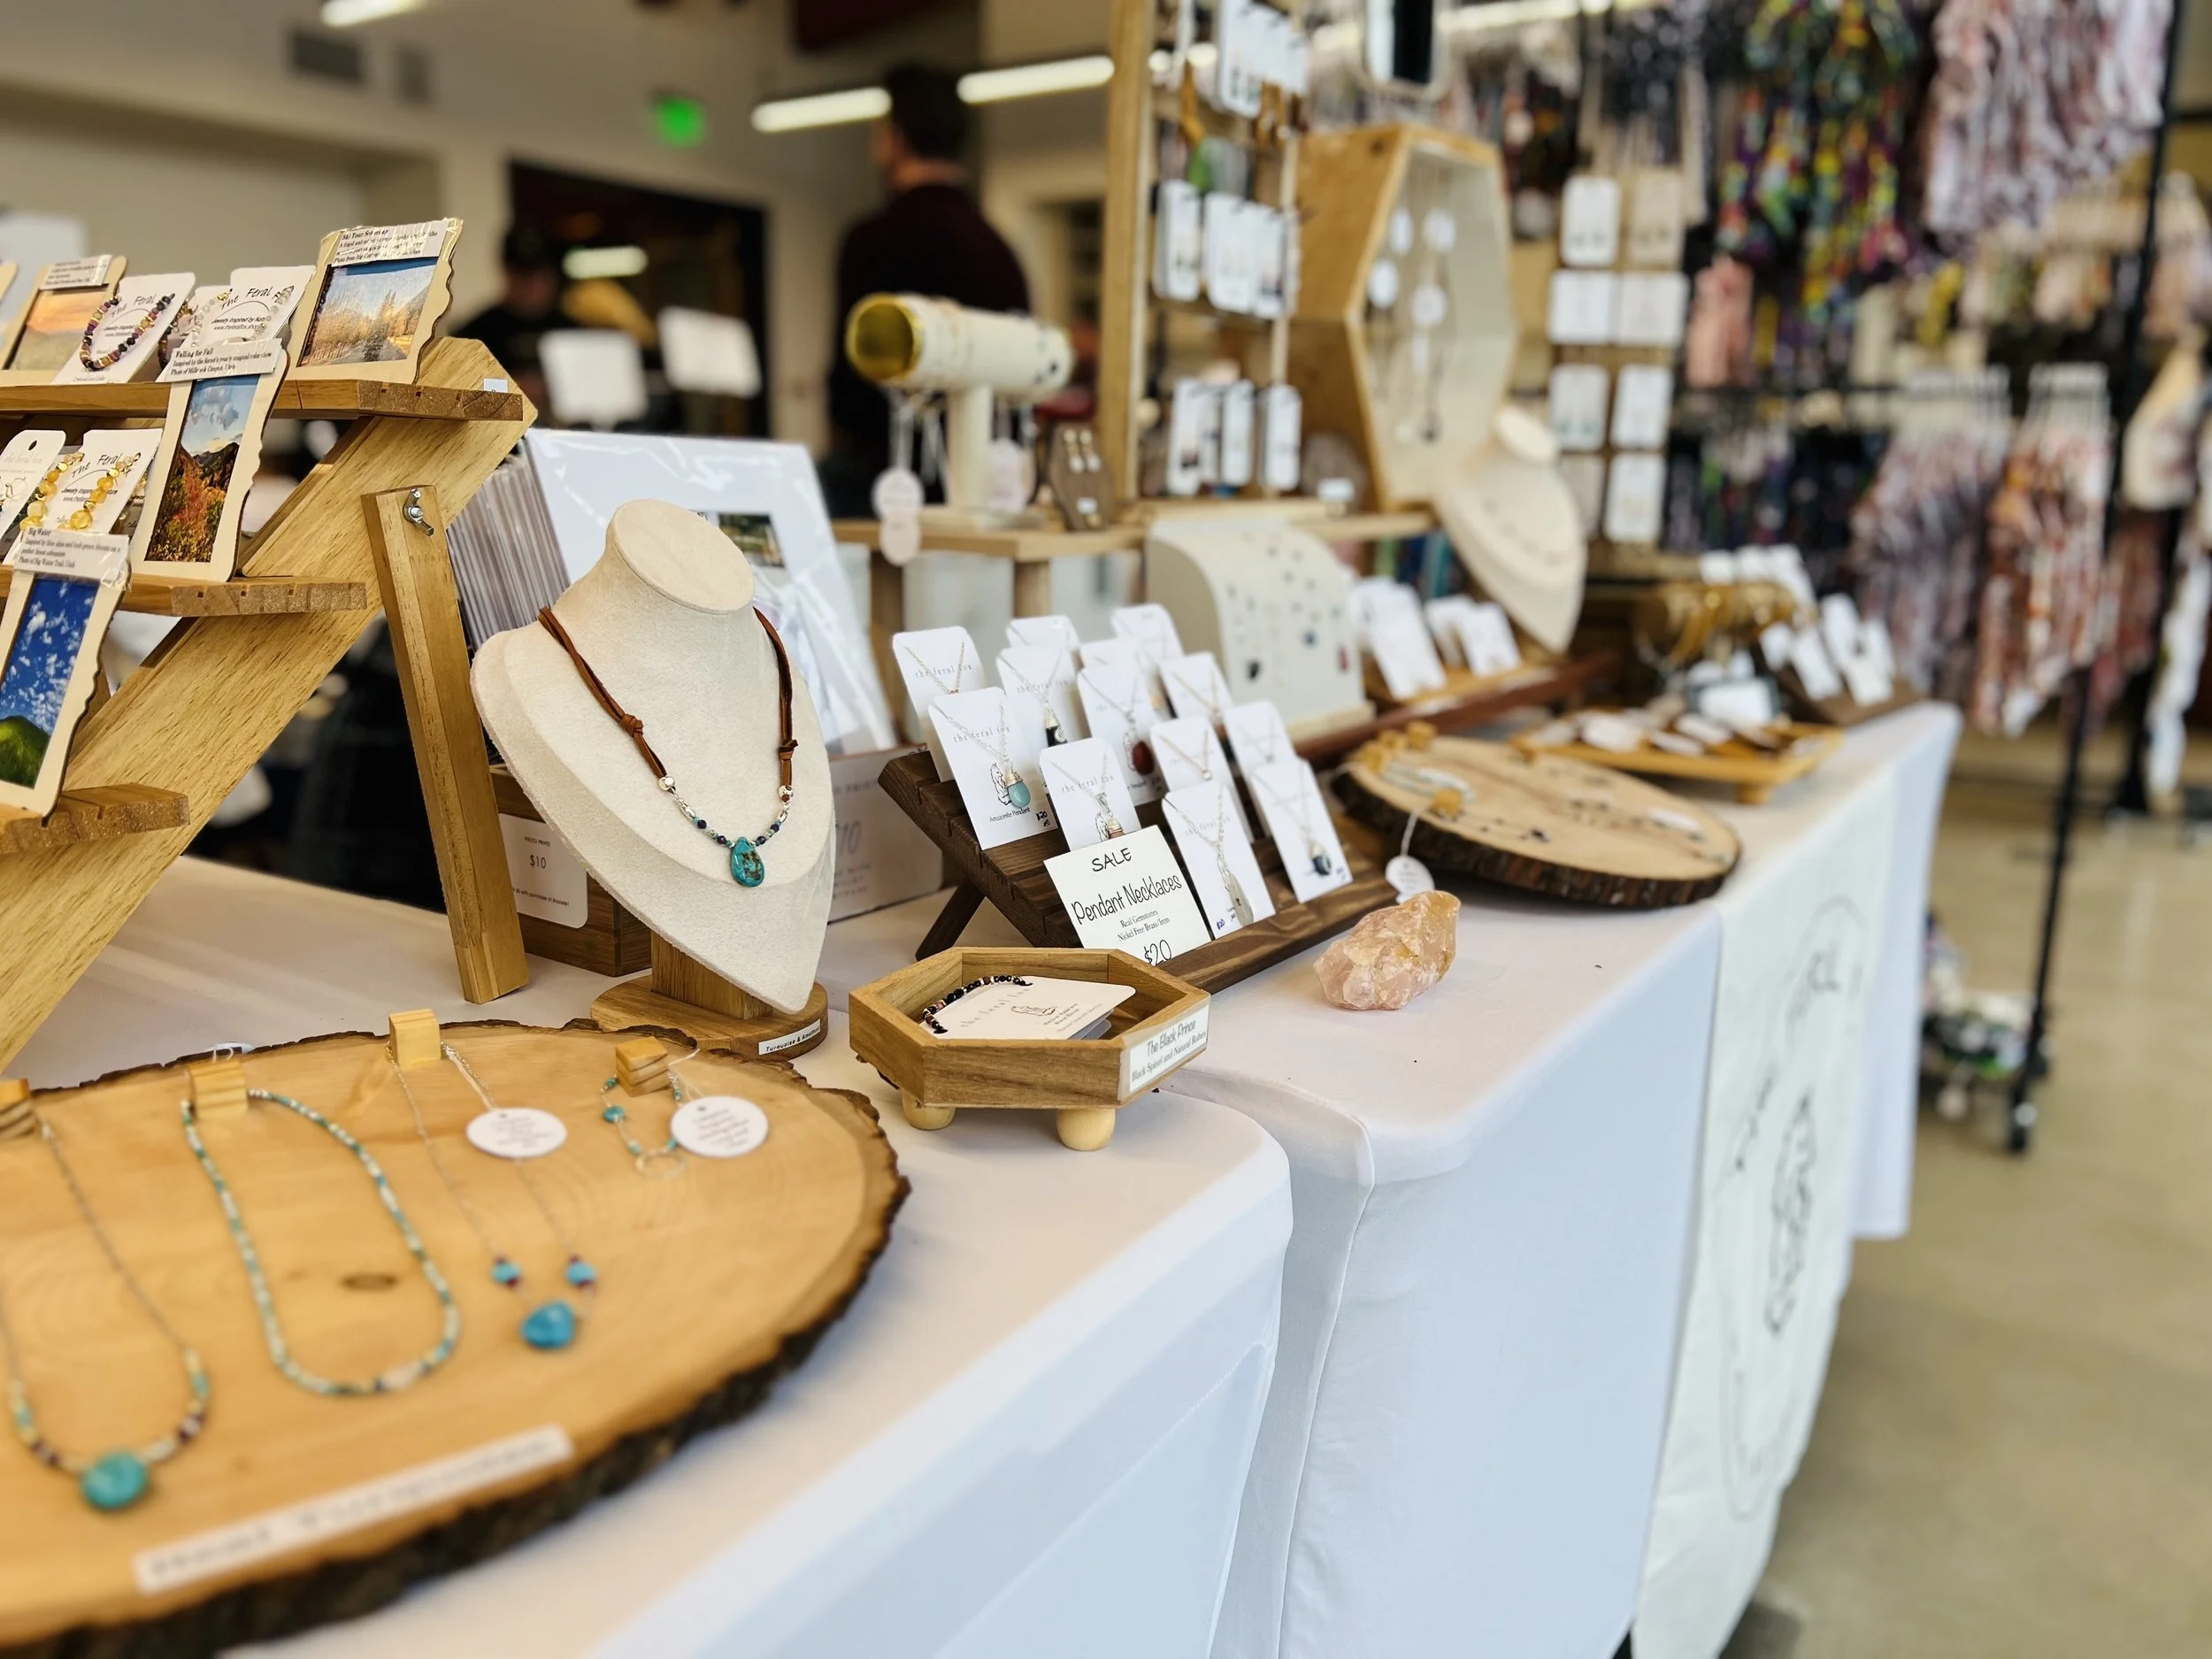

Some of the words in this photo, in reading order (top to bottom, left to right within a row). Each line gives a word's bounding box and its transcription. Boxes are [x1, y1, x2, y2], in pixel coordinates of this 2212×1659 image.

[134, 294, 157, 306] Feral
[221, 296, 239, 310] The
[246, 287, 273, 298] Feral
[72, 462, 90, 478] The
[97, 453, 123, 465] Feral
[28, 527, 37, 536] Big
[915, 669, 929, 680] the
[953, 733, 967, 743] the
[1062, 784, 1074, 794] the
[1012, 806, 1031, 817] Pendant
[529, 854, 547, 869] $10
[1091, 847, 1133, 872] SALE
[1071, 890, 1126, 926] Pendant
[1122, 874, 1183, 906] Necklaces
[1119, 918, 1133, 928] Real
[1132, 910, 1159, 924] Gemstones
[1118, 928, 1134, 941] Nickel
[1133, 926, 1145, 936] Free
[1144, 917, 1171, 932] Brass/Iron
[1143, 939, 1172, 966] $20
[765, 1040, 795, 1052] Turquoise
[1147, 1040, 1159, 1057] The
[1159, 1027, 1177, 1049] Black
[1178, 1019, 1196, 1039] Prince
[1132, 1066, 1146, 1081] Black
[1164, 1049, 1172, 1063] and
